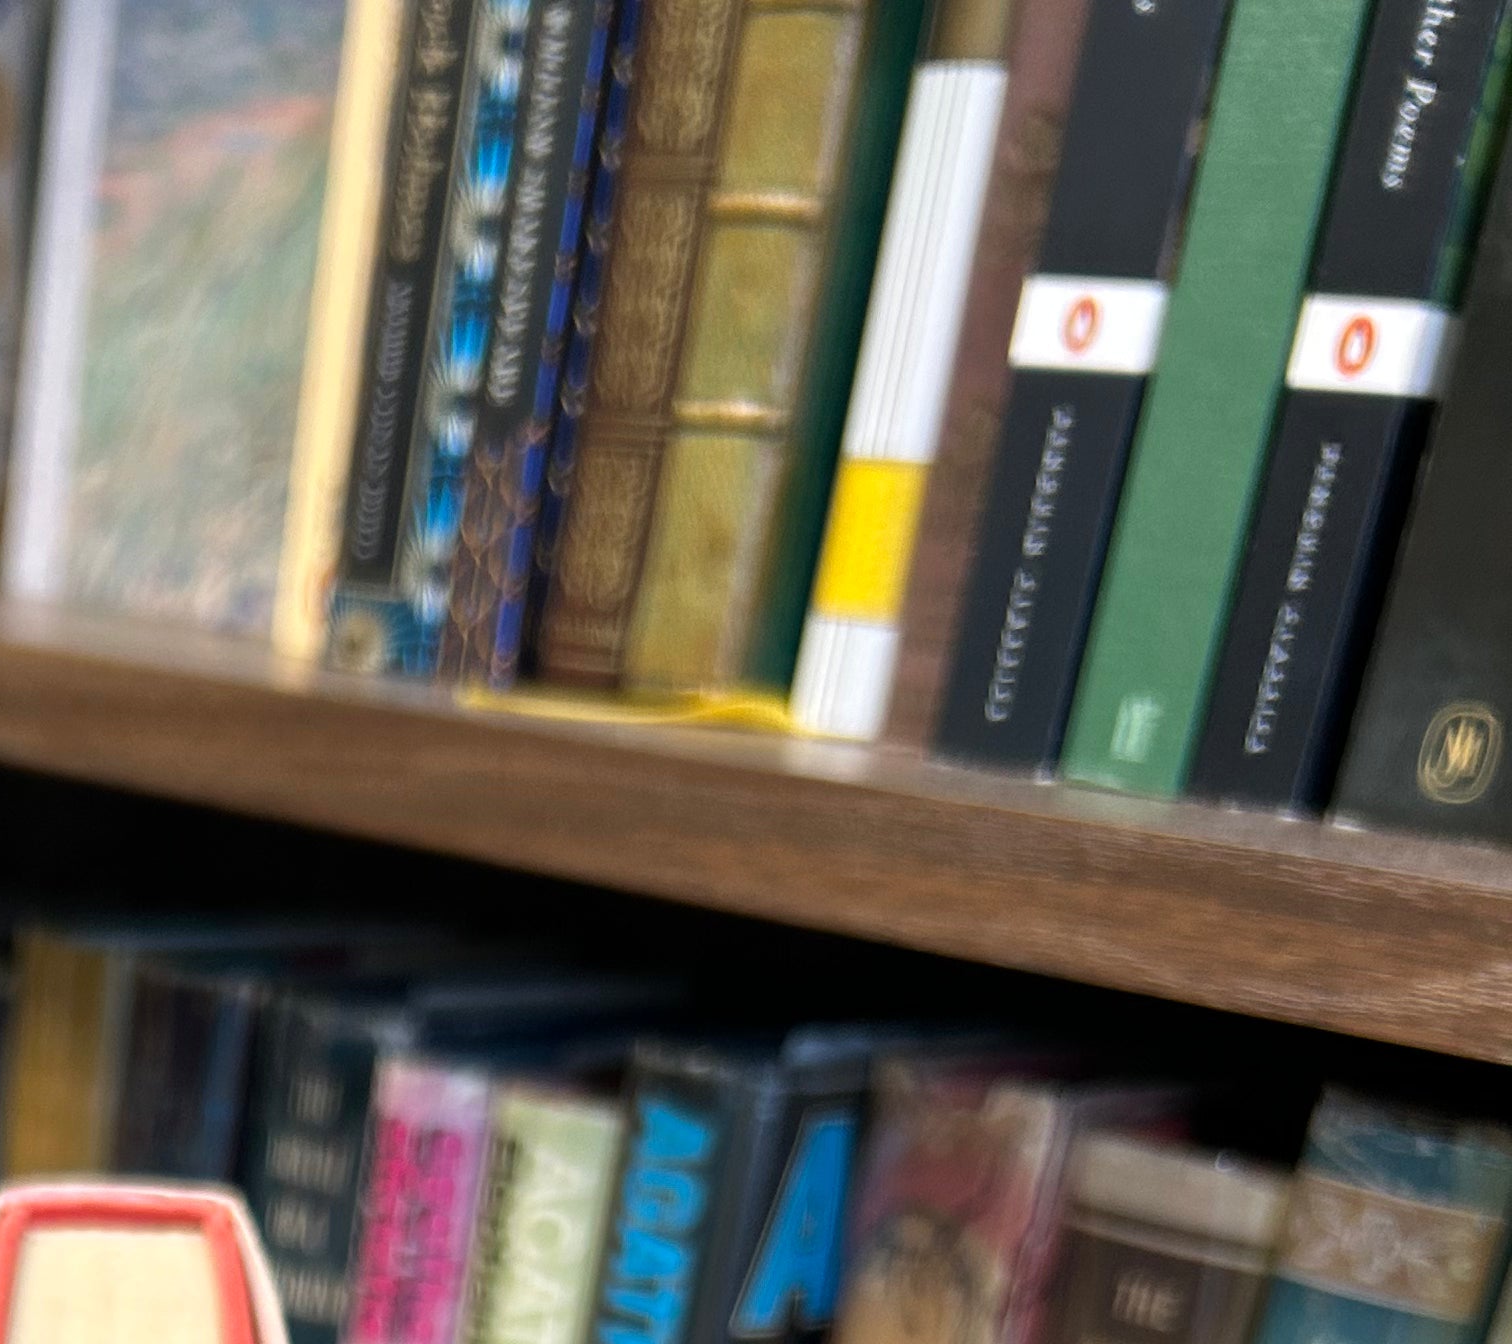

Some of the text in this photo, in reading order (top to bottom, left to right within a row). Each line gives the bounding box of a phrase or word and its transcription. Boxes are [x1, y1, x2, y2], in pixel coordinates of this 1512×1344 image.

[1381, 0, 1456, 190] her Poems
[1113, 1269, 1183, 1330] THE
